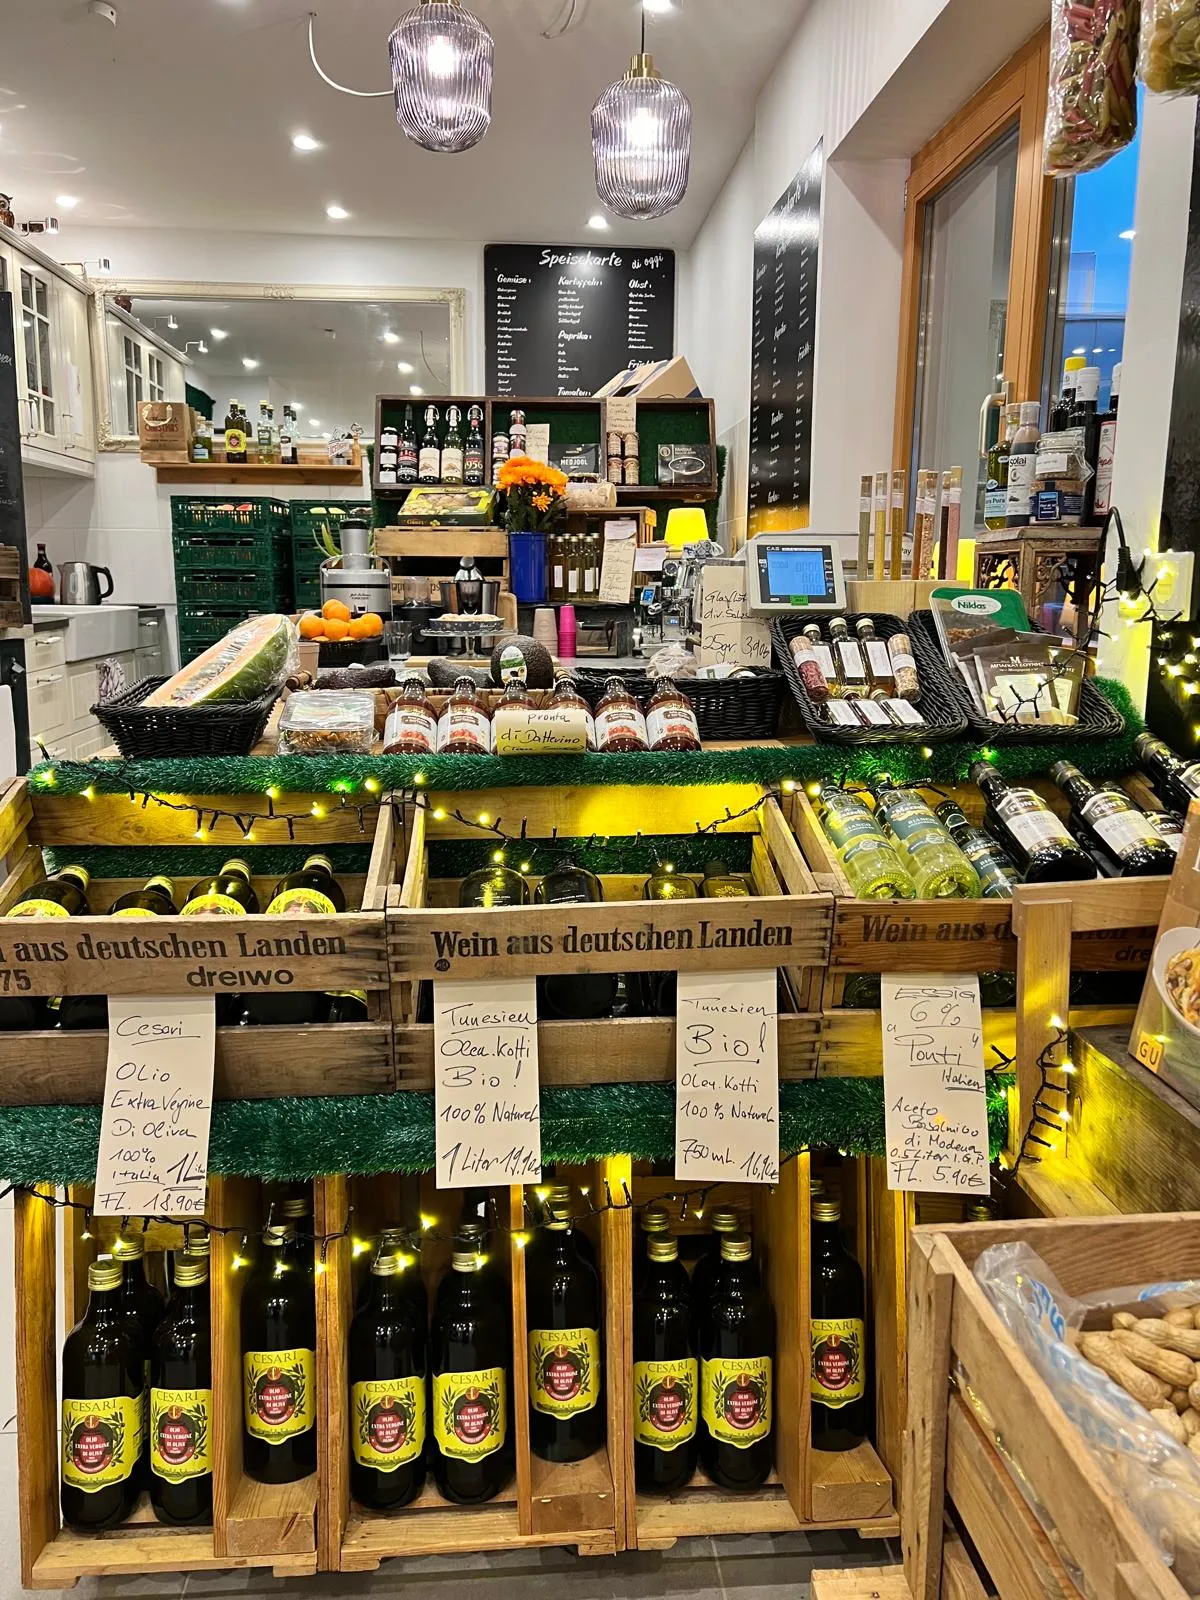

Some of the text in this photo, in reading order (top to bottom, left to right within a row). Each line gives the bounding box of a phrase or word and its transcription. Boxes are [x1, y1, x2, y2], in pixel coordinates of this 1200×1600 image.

[538, 249, 664, 270] Speisekarte di oggi
[557, 330, 592, 341] Paprika:
[901, 546, 912, 555] ay
[527, 712, 571, 725] pronta
[862, 914, 928, 943] Wein
[936, 920, 986, 941] aus
[431, 919, 792, 958] Wein aus deutschen Landen
[14, 940, 69, 962] aus
[76, 933, 227, 960] deutschen
[236, 930, 347, 958] Landen
[187, 966, 294, 987] dreiwo
[441, 1003, 537, 1027] Tunesien
[116, 1015, 183, 1036] Cesari
[894, 1033, 962, 1066] Ponti
[892, 1096, 938, 1115] Aceto
[905, 1132, 921, 1147] di
[812, 1319, 853, 1332] CESARI
[540, 1330, 582, 1342] CESARI
[253, 1351, 297, 1364] CESARI
[648, 1361, 688, 1373] CESARI
[722, 1359, 763, 1371] CESARI
[451, 1371, 492, 1385] CESARI
[366, 1379, 409, 1393] CESARI
[156, 1391, 198, 1403] CESARI
[71, 1399, 117, 1412] CESARI
